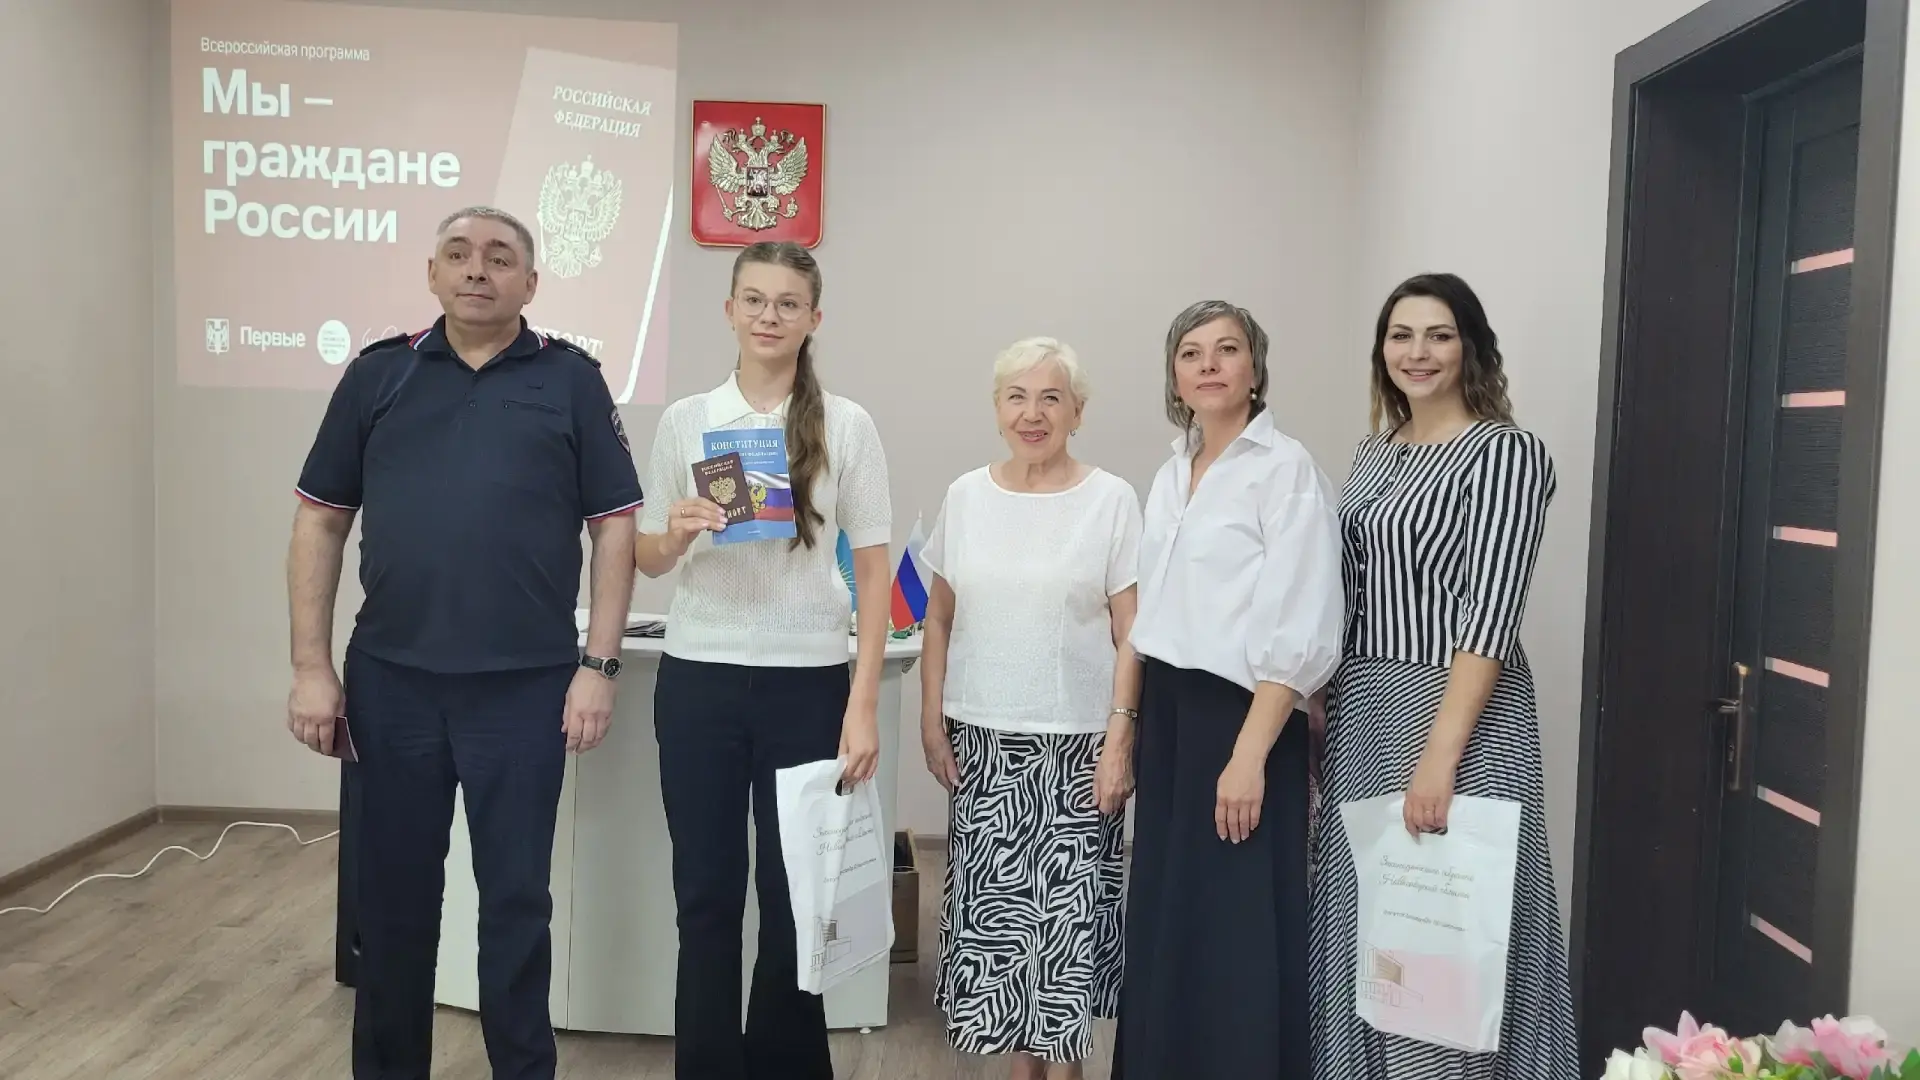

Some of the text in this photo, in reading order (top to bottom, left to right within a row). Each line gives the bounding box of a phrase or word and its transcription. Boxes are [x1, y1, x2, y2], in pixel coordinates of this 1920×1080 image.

[200, 36, 371, 63] Всероссийская программа
[202, 67, 290, 118] Мы
[552, 85, 652, 116] РОССИЙСКАЯ
[553, 109, 642, 139] ФЕДЕРАЦИЯ
[203, 139, 461, 190] граждане
[204, 188, 398, 243] России
[240, 325, 306, 351] Первые
[711, 439, 778, 451] КОНСТИТУЦИЯ
